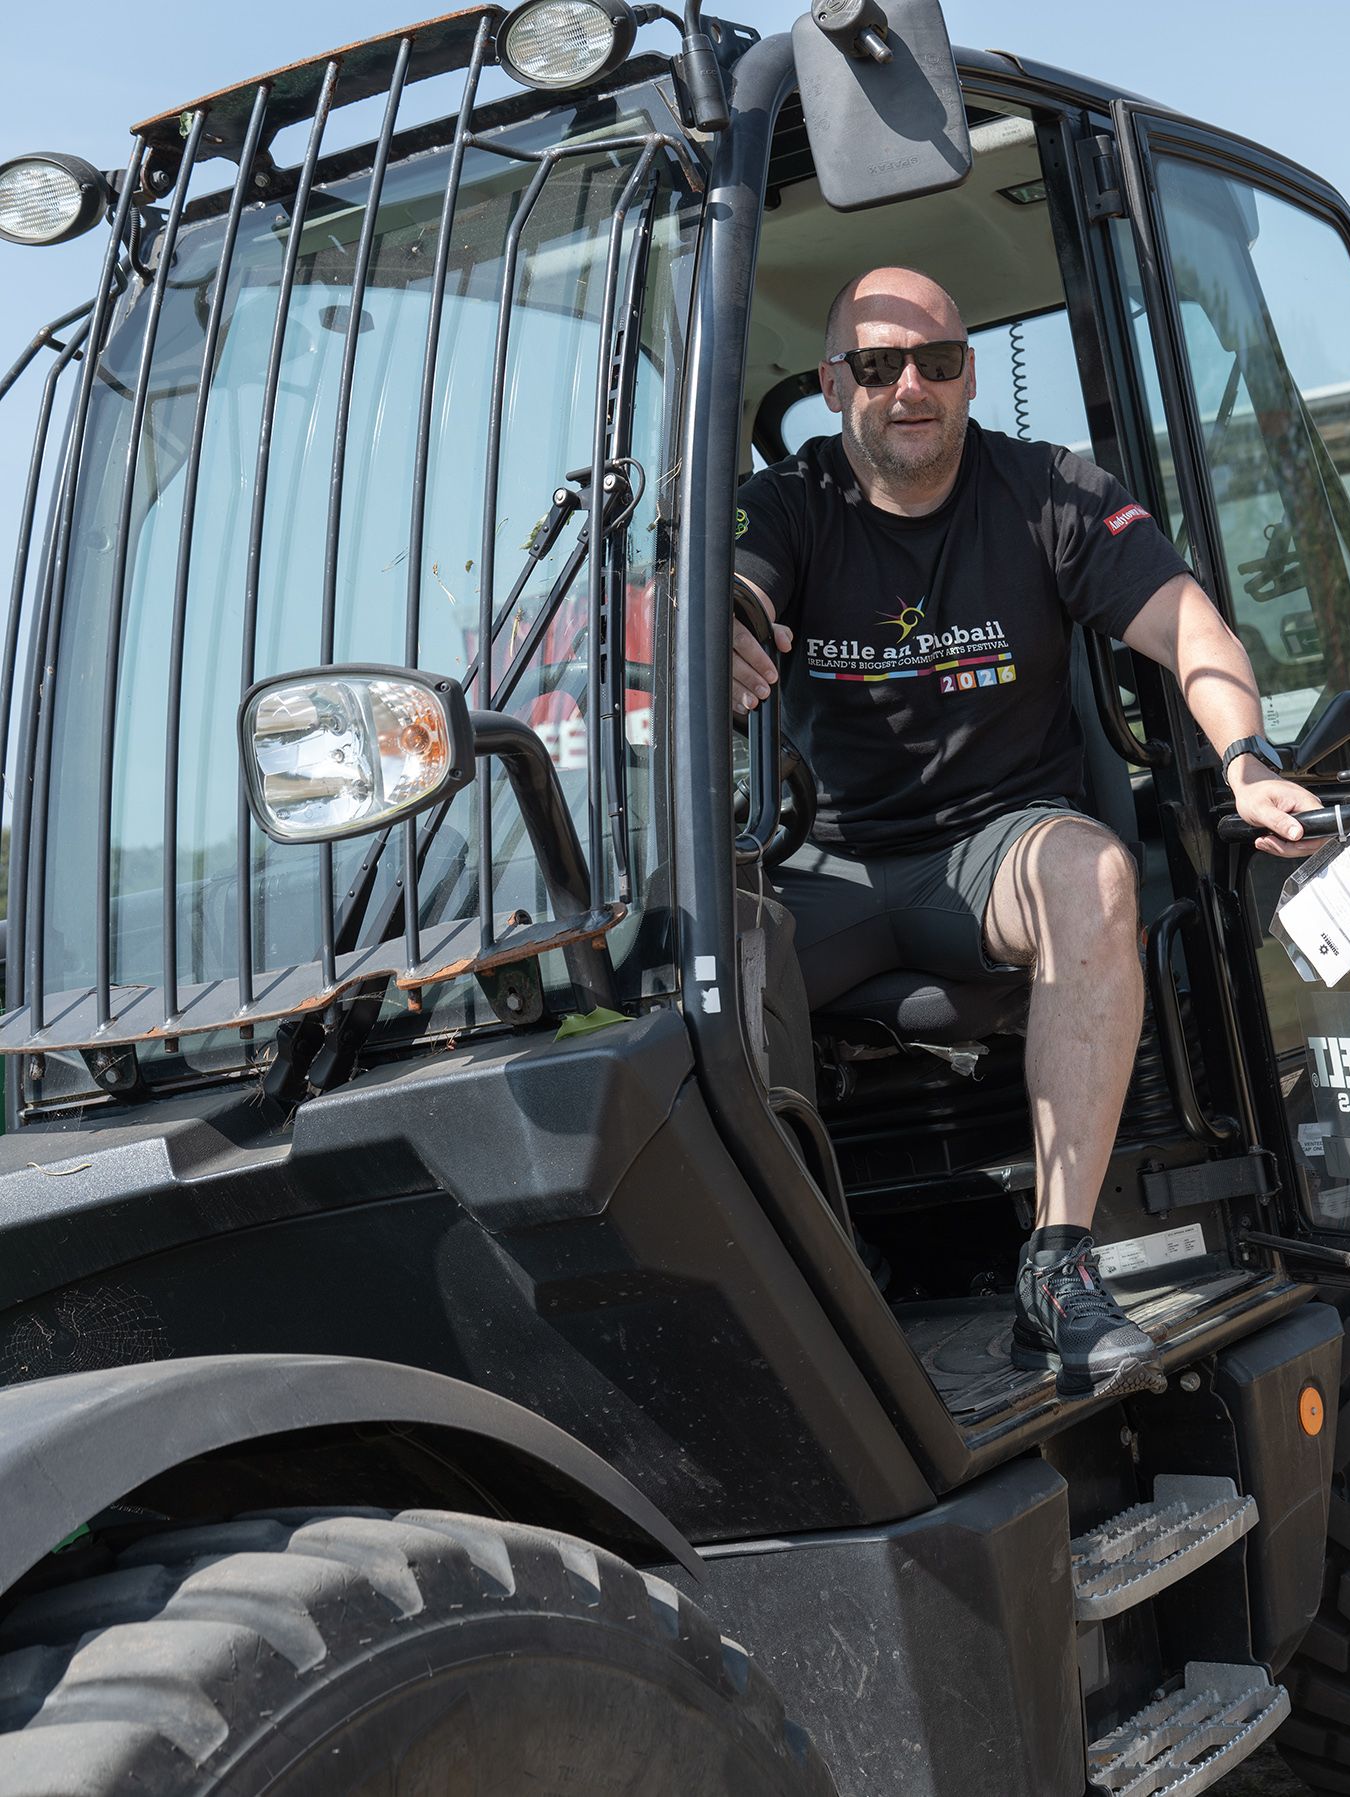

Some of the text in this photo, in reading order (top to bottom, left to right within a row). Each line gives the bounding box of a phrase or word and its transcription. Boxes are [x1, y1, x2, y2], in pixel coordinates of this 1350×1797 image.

[807, 638, 876, 660] Féile
[807, 657, 857, 669] IRELAND'S
[859, 660, 897, 670] BIGGEST
[945, 645, 966, 656] ARTS
[966, 640, 1009, 653] FESTIVAL
[942, 666, 1013, 693] 2026
